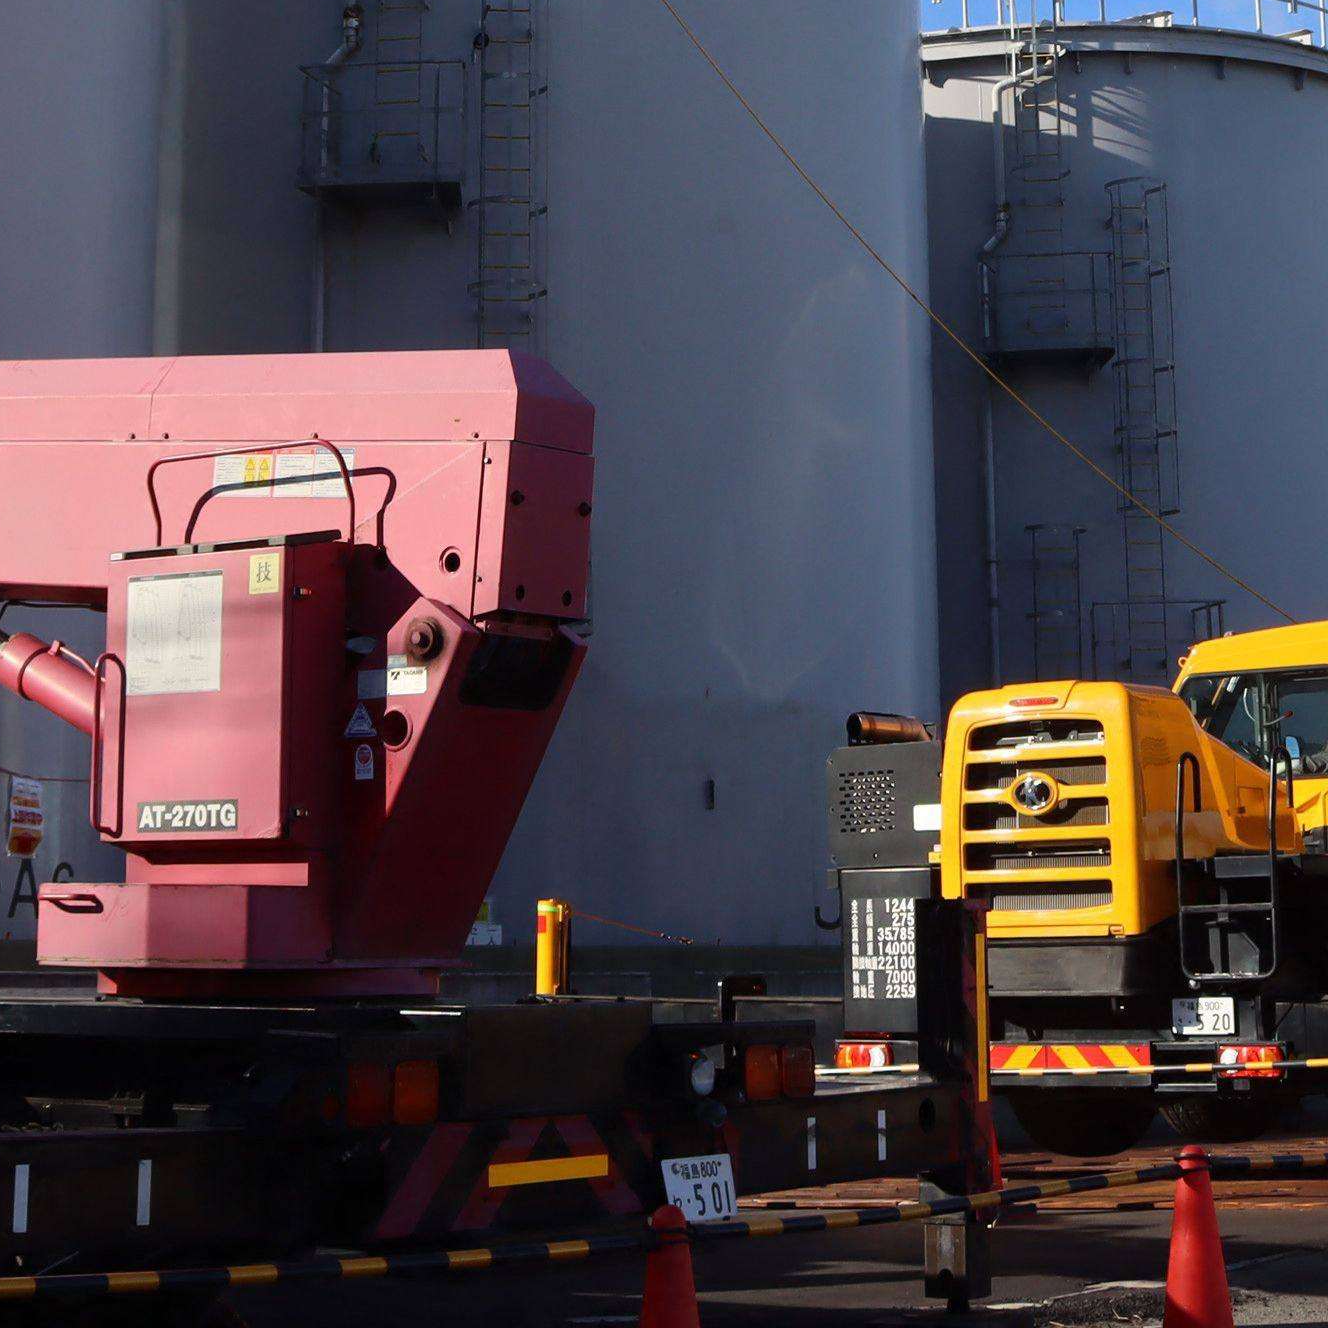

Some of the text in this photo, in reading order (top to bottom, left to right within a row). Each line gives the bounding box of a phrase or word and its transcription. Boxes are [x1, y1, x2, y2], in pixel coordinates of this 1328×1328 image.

[139, 803, 236, 828] AT-270TG
[877, 927, 915, 941] 35.785
[878, 941, 915, 955] 14.000
[878, 956, 915, 970] 22.100
[885, 970, 916, 984] 7.000
[701, 1160, 718, 1178] 800
